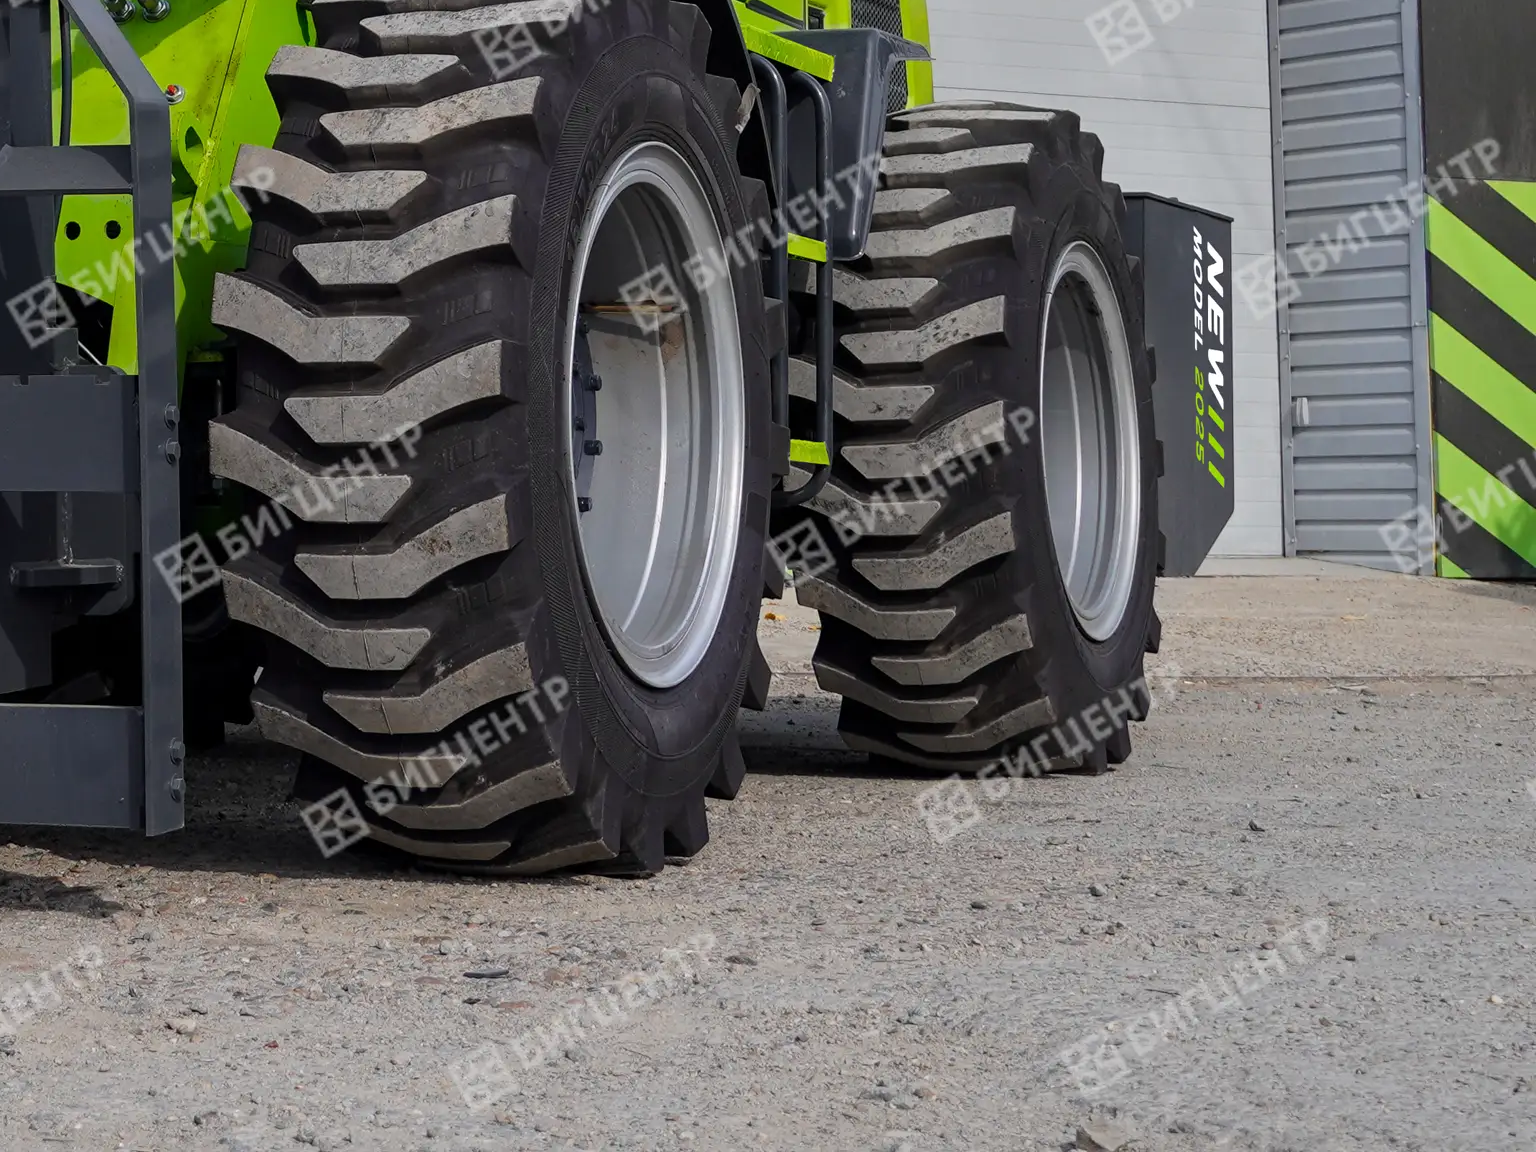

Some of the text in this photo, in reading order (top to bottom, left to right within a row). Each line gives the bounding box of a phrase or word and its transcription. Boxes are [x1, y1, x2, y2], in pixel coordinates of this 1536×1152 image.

[1193, 225, 1205, 465] MODEL 2025
[1207, 241, 1225, 410] NEW
